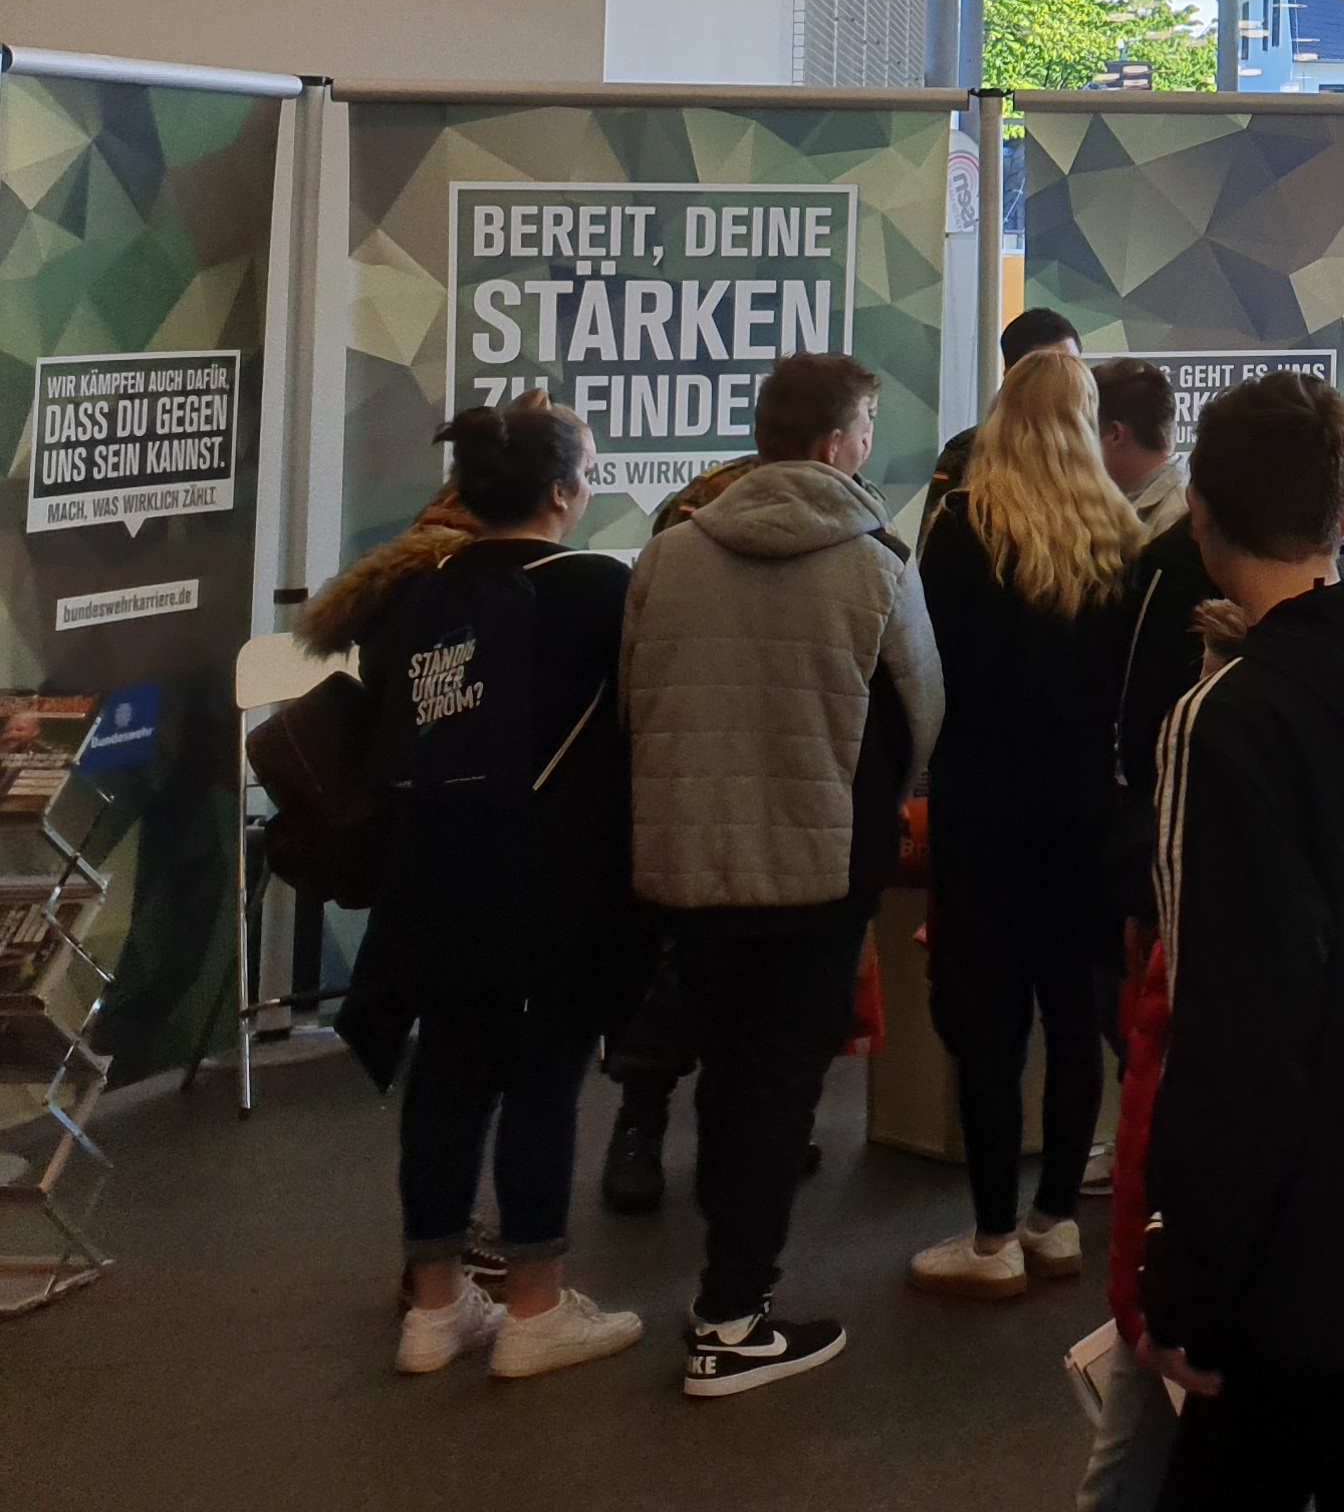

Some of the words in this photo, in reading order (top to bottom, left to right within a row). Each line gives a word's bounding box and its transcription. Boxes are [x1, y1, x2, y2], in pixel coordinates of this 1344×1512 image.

[473, 205, 664, 266] BEREIT,
[685, 206, 832, 258] DEINE
[472, 260, 831, 364] STÄRKEN
[48, 375, 75, 398] WIR
[80, 369, 145, 396] KÄMPFEN
[149, 369, 182, 392] AUCH
[187, 364, 230, 391] DAFÜR,
[1180, 365, 1234, 388] GEHT
[44, 401, 108, 444] DASS
[117, 399, 148, 437] DU
[156, 394, 228, 435] GEGEN
[574, 374, 770, 437] FINDE
[42, 447, 87, 485] UNS
[93, 442, 140, 480] SEIN
[146, 436, 226, 474] KANNST.
[588, 461, 617, 485] AS
[47, 503, 87, 524] MACH,
[92, 497, 118, 518] WAS
[123, 492, 180, 514] WIRKLICH
[63, 587, 192, 623] bundeswehrkarriere.de
[412, 665, 465, 703] UNTER
[416, 681, 484, 726] STROM?
